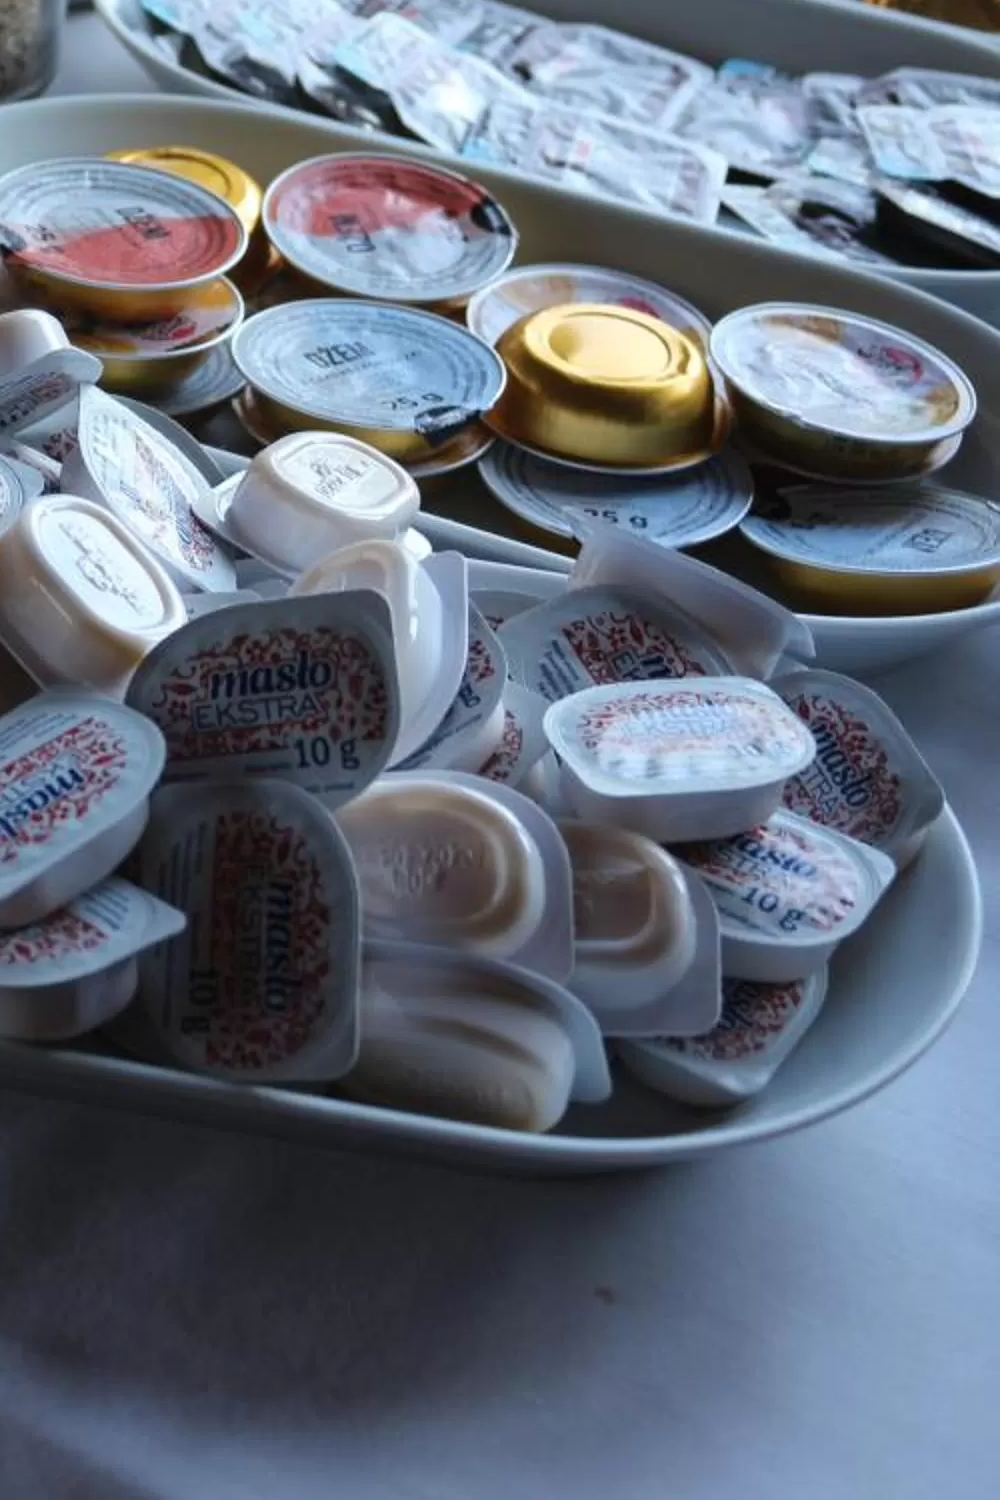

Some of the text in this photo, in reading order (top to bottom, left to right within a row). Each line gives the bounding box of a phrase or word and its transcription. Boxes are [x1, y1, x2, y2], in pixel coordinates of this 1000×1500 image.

[195, 695, 320, 729] EKSTRA
[296, 737, 361, 770] 10 g
[799, 764, 842, 812] STRA
[740, 886, 778, 914] 10
[779, 909, 806, 932] g
